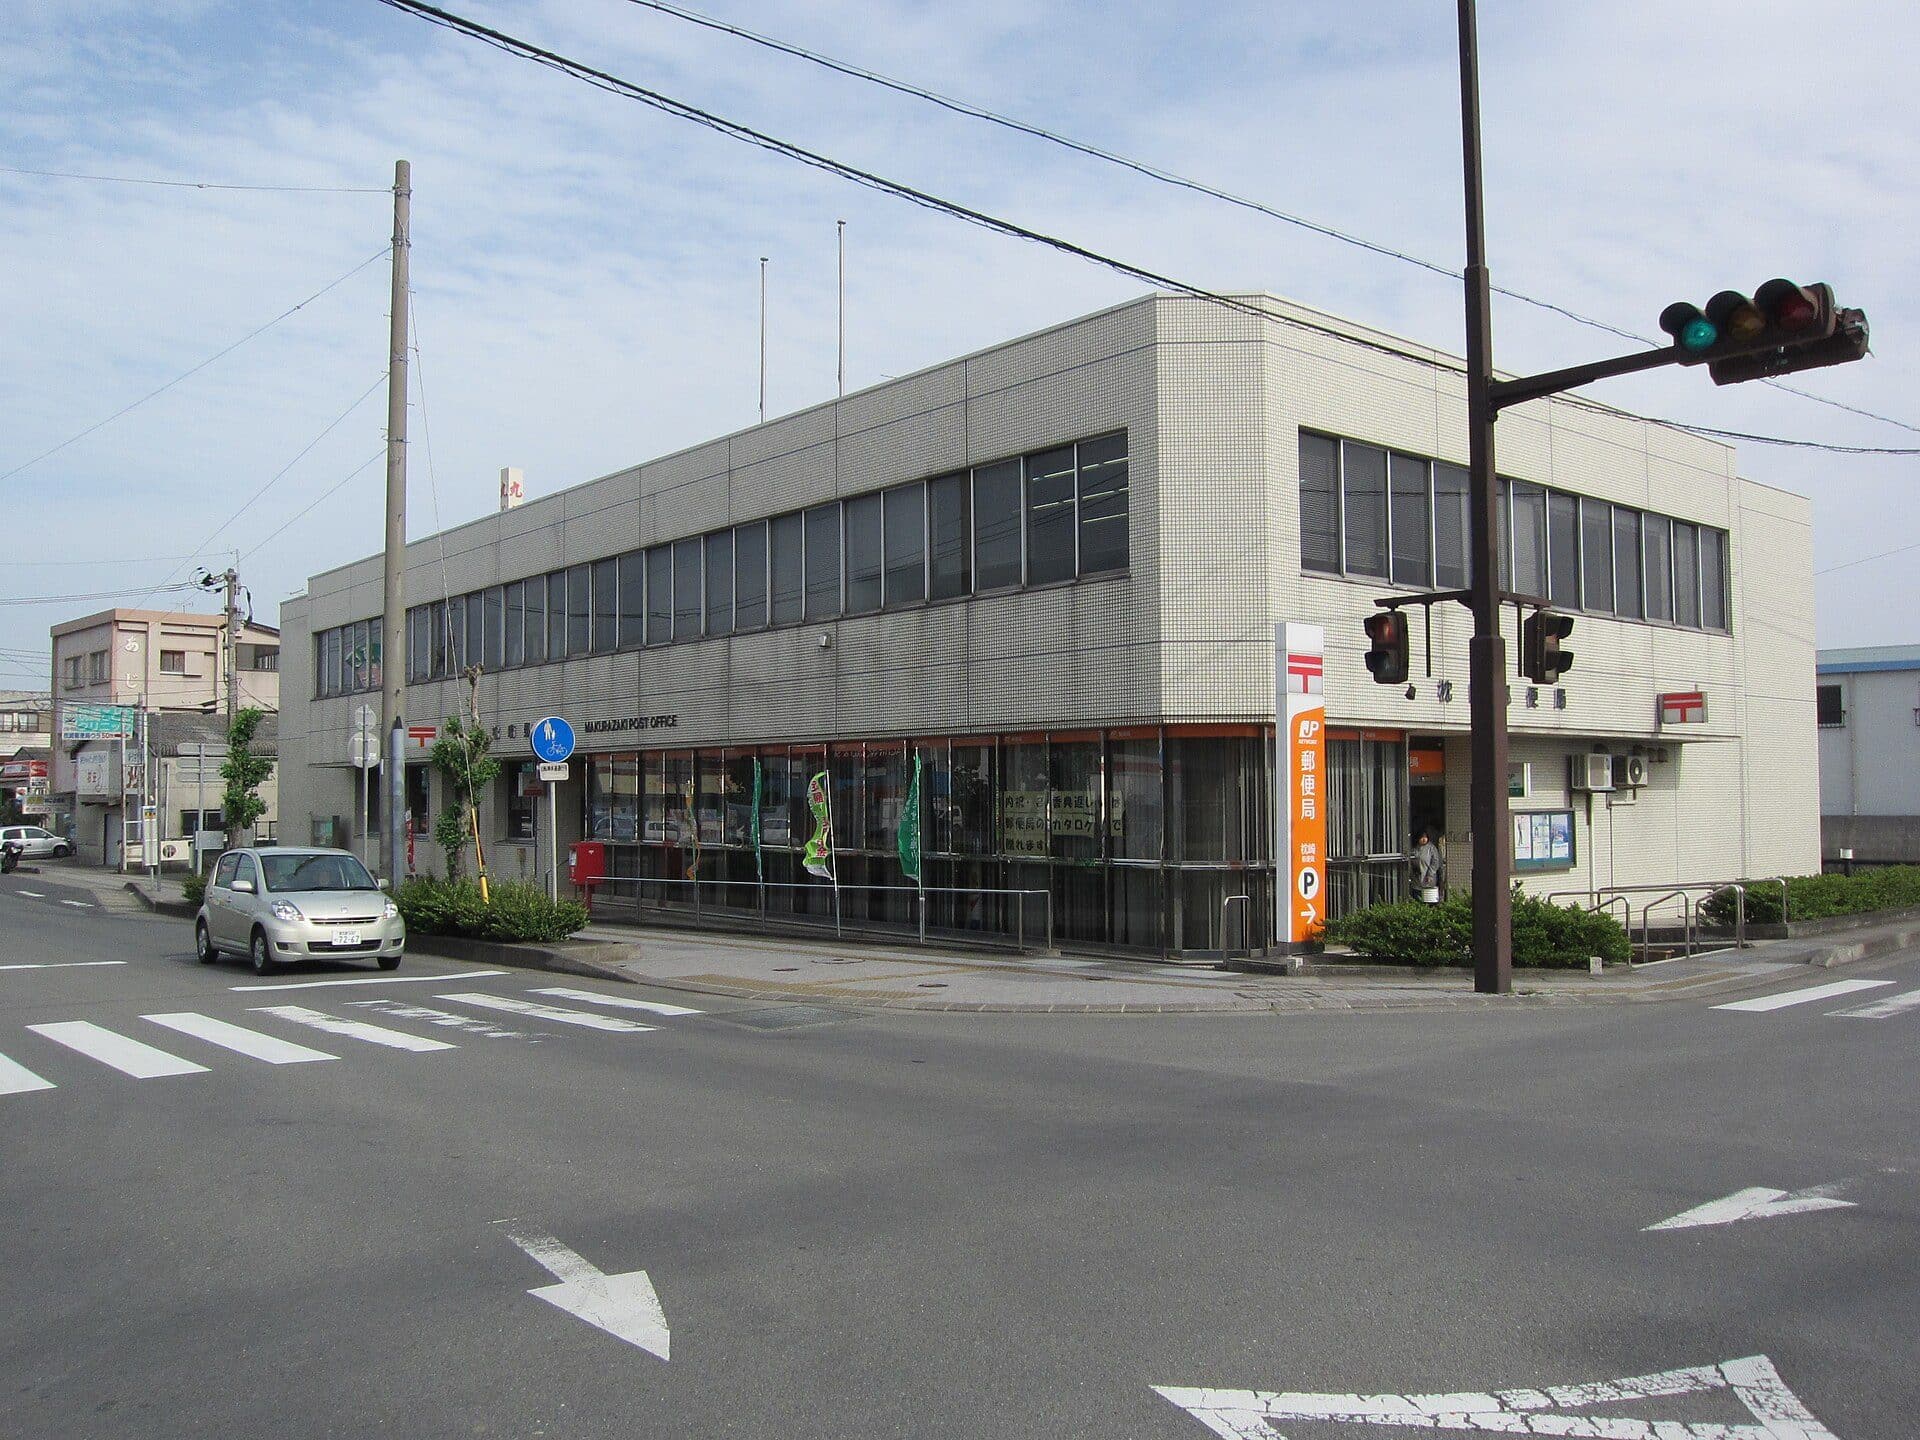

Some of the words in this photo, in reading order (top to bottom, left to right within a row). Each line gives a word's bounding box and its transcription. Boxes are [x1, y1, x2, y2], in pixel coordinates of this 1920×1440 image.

[125, 635, 139, 689] あじ
[584, 717, 629, 733] MAKURAZAKI
[629, 716, 649, 730] POST
[650, 714, 678, 728] OFFICE
[1301, 750, 1316, 819] 郵便局
[1303, 871, 1315, 895] P
